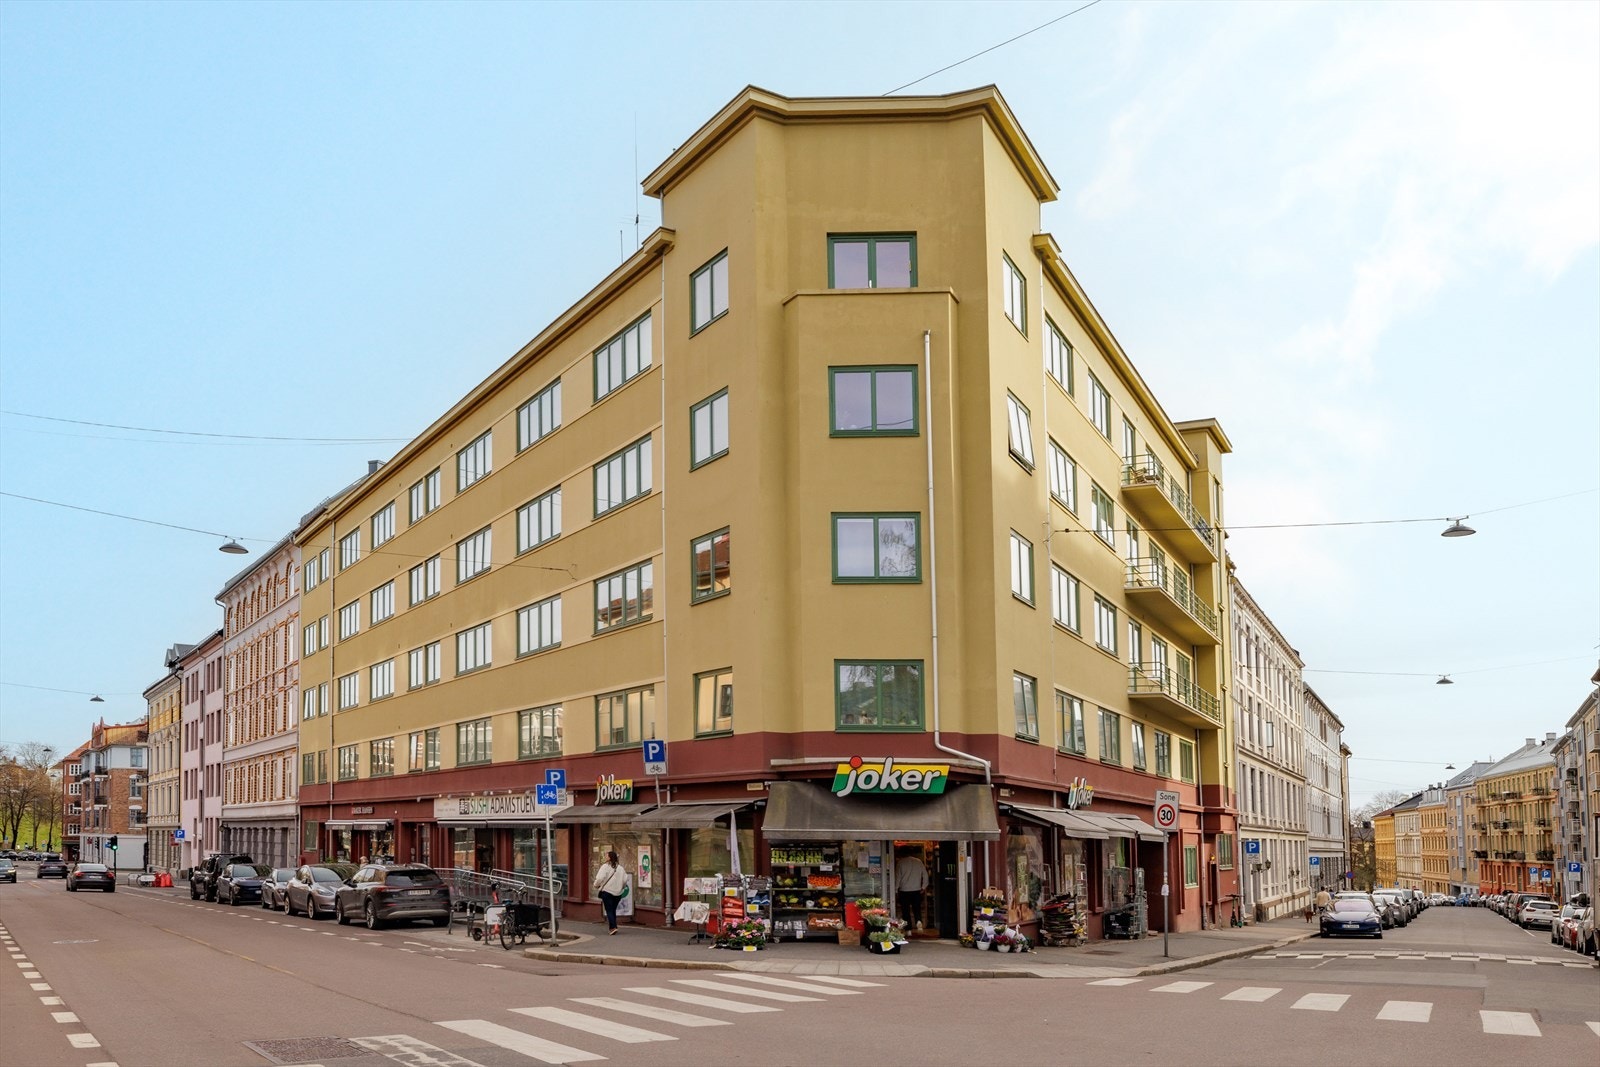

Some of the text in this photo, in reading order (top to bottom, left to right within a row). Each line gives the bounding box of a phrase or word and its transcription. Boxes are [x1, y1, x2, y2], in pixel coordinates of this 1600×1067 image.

[648, 743, 660, 760] P
[550, 771, 561, 785] P
[837, 755, 942, 798] joker
[595, 774, 629, 806] joker
[1069, 777, 1094, 810] joker
[1160, 792, 1176, 801] Sone
[470, 797, 489, 815] SUSHI
[490, 795, 536, 814] ADAMSTUEN
[1161, 809, 1173, 821] 30
[1249, 842, 1256, 852] P
[1571, 863, 1578, 871] P
